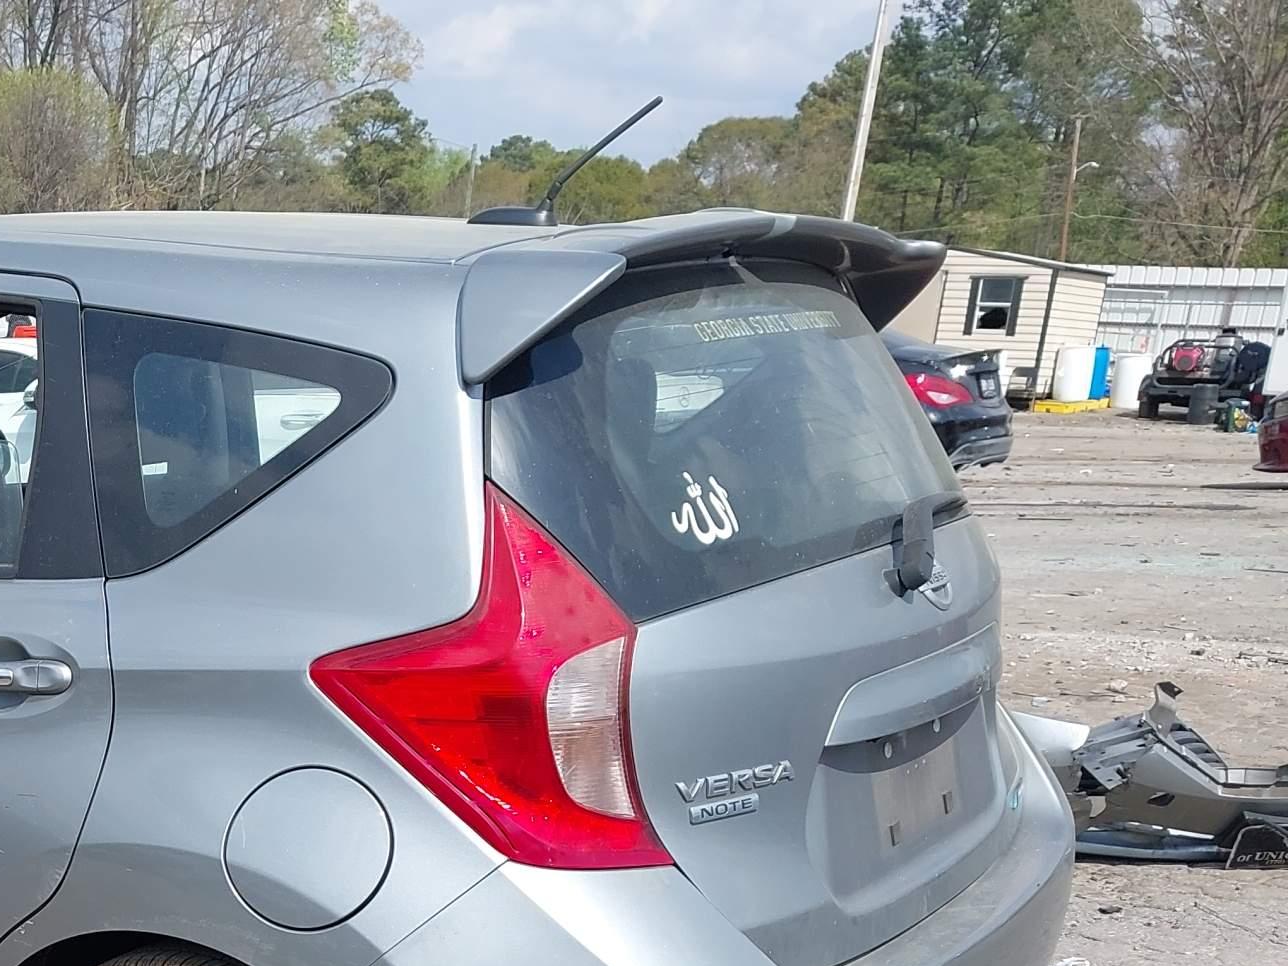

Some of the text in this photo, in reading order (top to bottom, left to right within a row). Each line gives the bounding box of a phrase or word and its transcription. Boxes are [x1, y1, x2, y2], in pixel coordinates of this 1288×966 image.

[693, 318, 755, 342] GEORGIA
[748, 313, 790, 334] STATE
[674, 759, 796, 803] VERSA
[700, 797, 753, 819] NOTE
